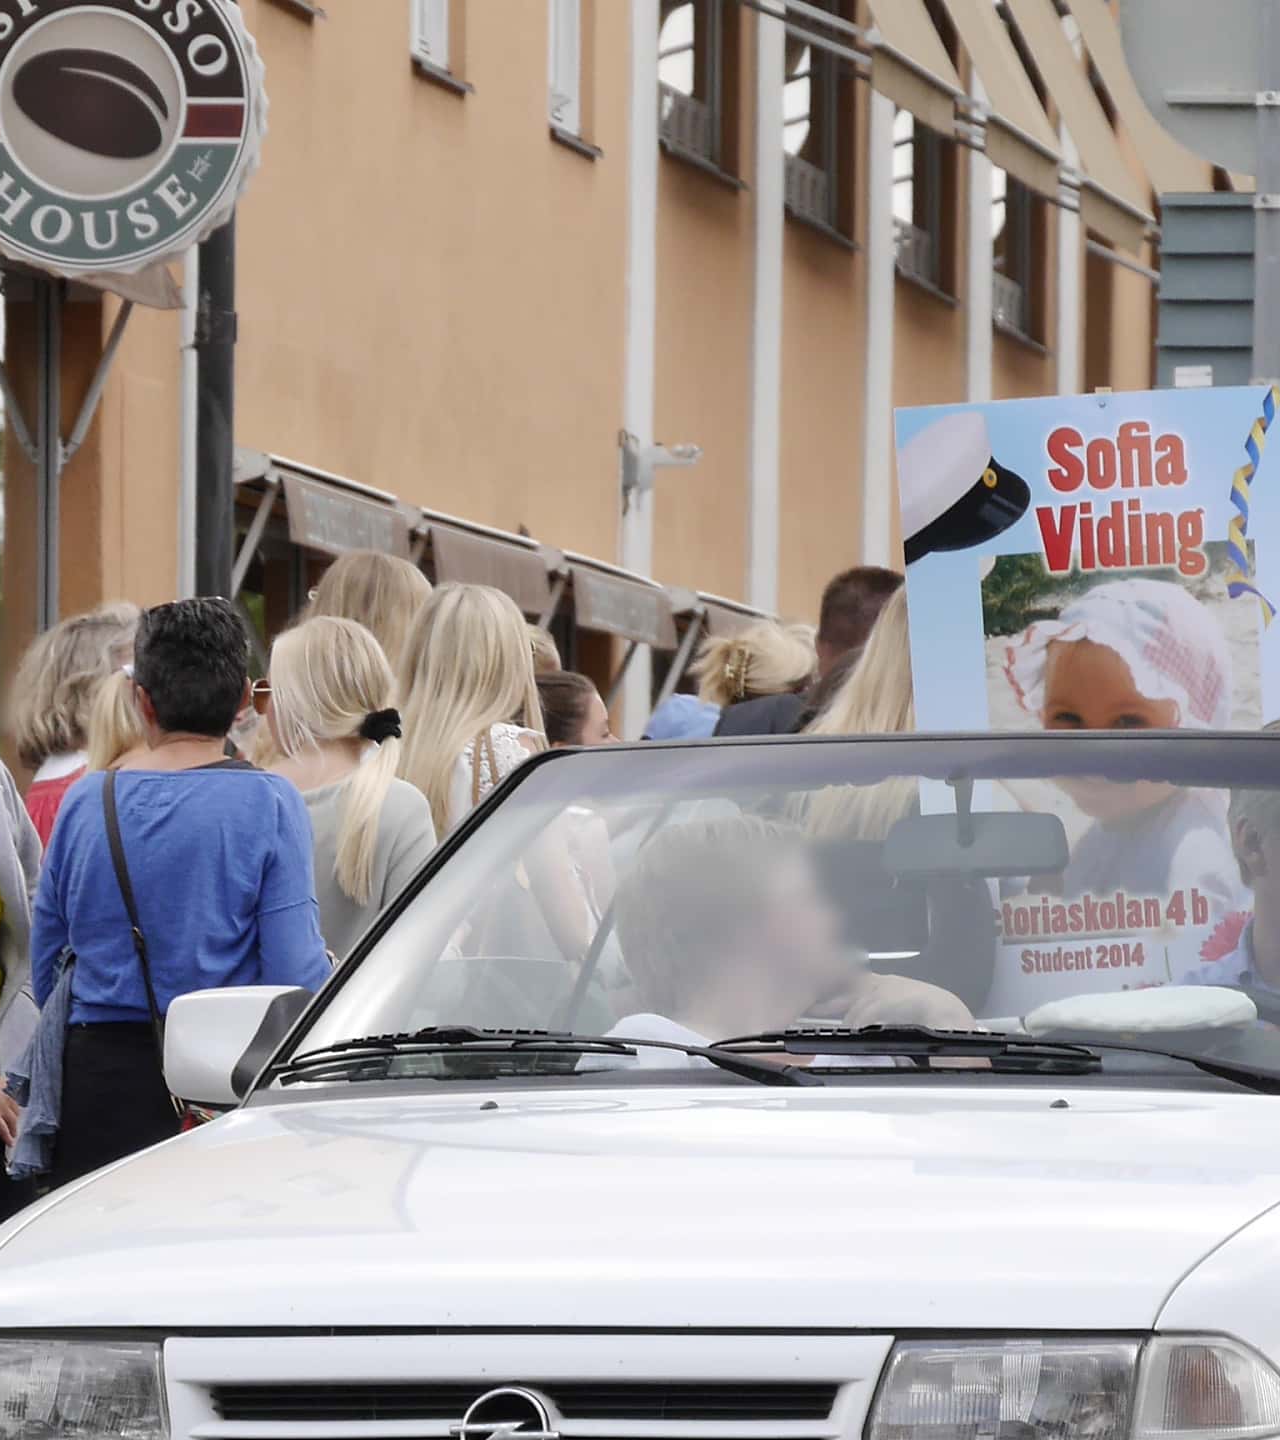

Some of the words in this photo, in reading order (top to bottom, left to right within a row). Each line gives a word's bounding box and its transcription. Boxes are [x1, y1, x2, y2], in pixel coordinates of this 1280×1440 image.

[1047, 420, 1188, 492] Sofia
[1036, 498, 1206, 576] Viding
[1166, 890, 1186, 926] 4
[1191, 888, 1209, 925] b
[1022, 946, 1093, 973] Student
[1096, 943, 1145, 969] 2014
